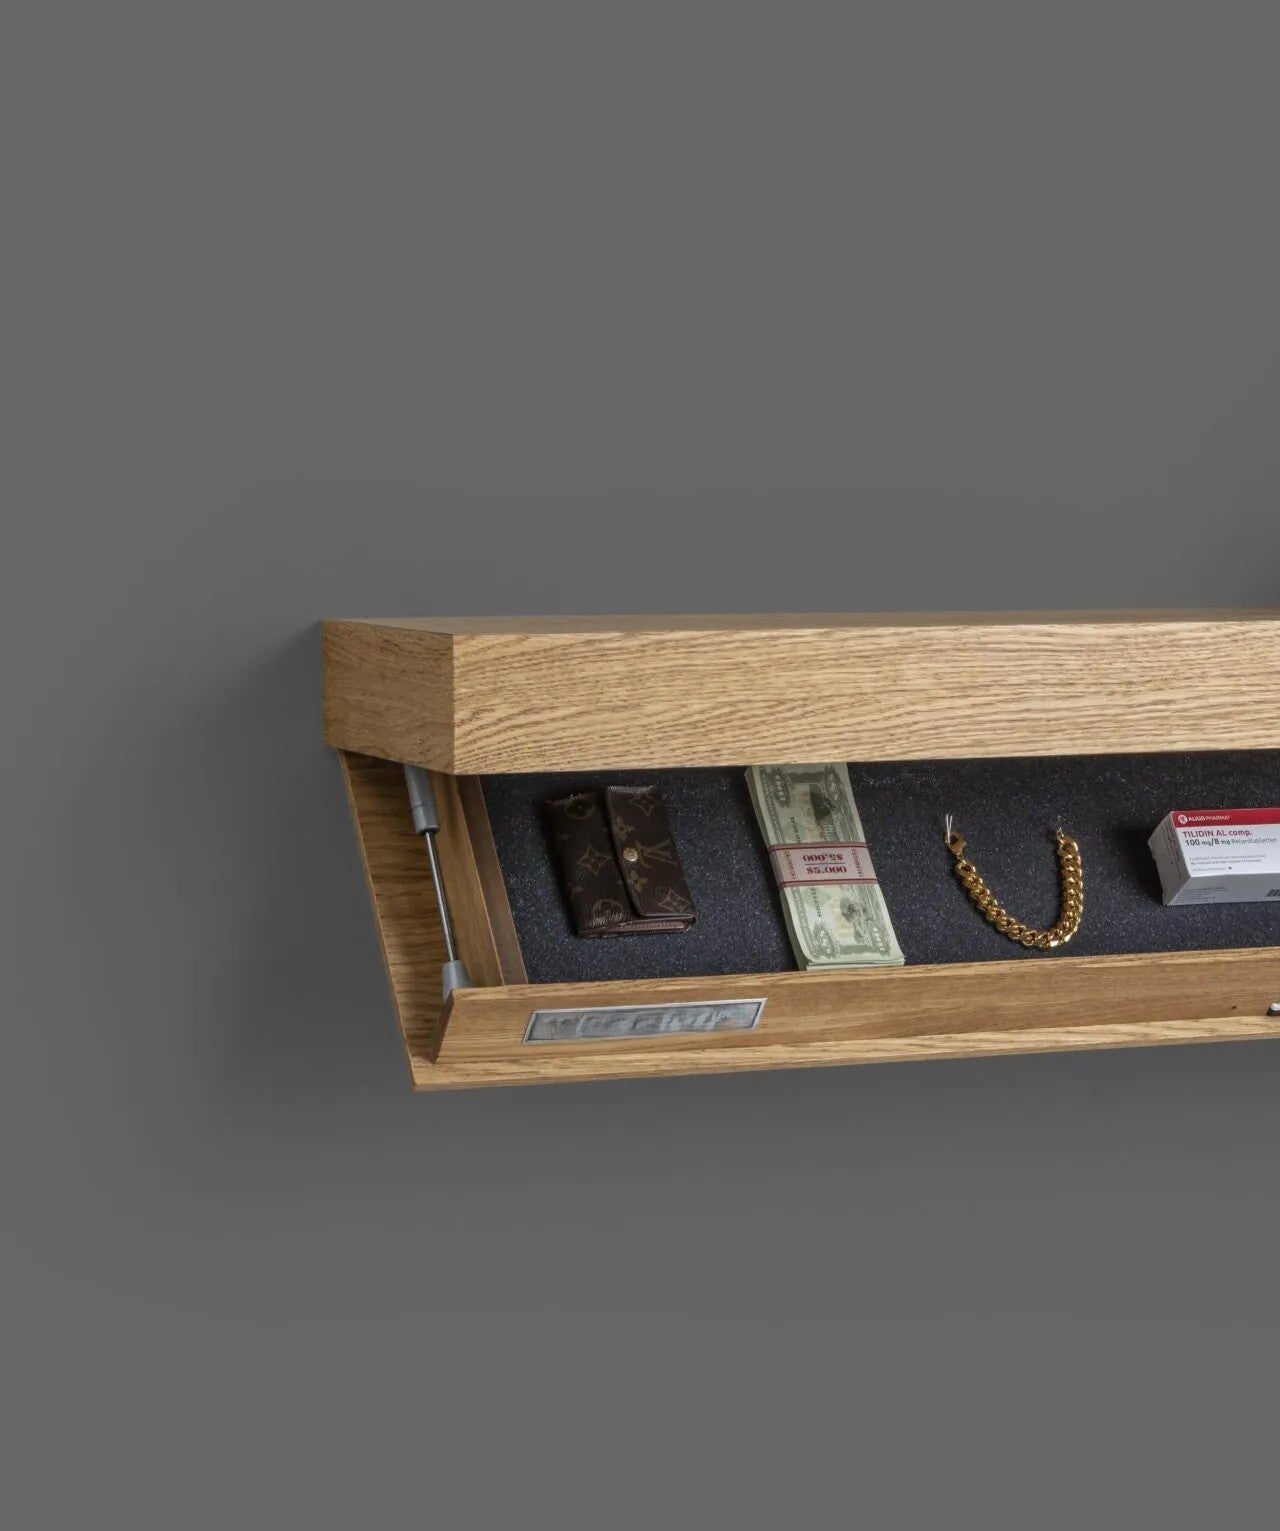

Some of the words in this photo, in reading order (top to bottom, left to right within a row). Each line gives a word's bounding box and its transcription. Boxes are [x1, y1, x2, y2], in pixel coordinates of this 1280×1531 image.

[1182, 830, 1214, 838] TILIDIN
[1228, 830, 1252, 838] comp.
[1185, 839, 1200, 847] 100
